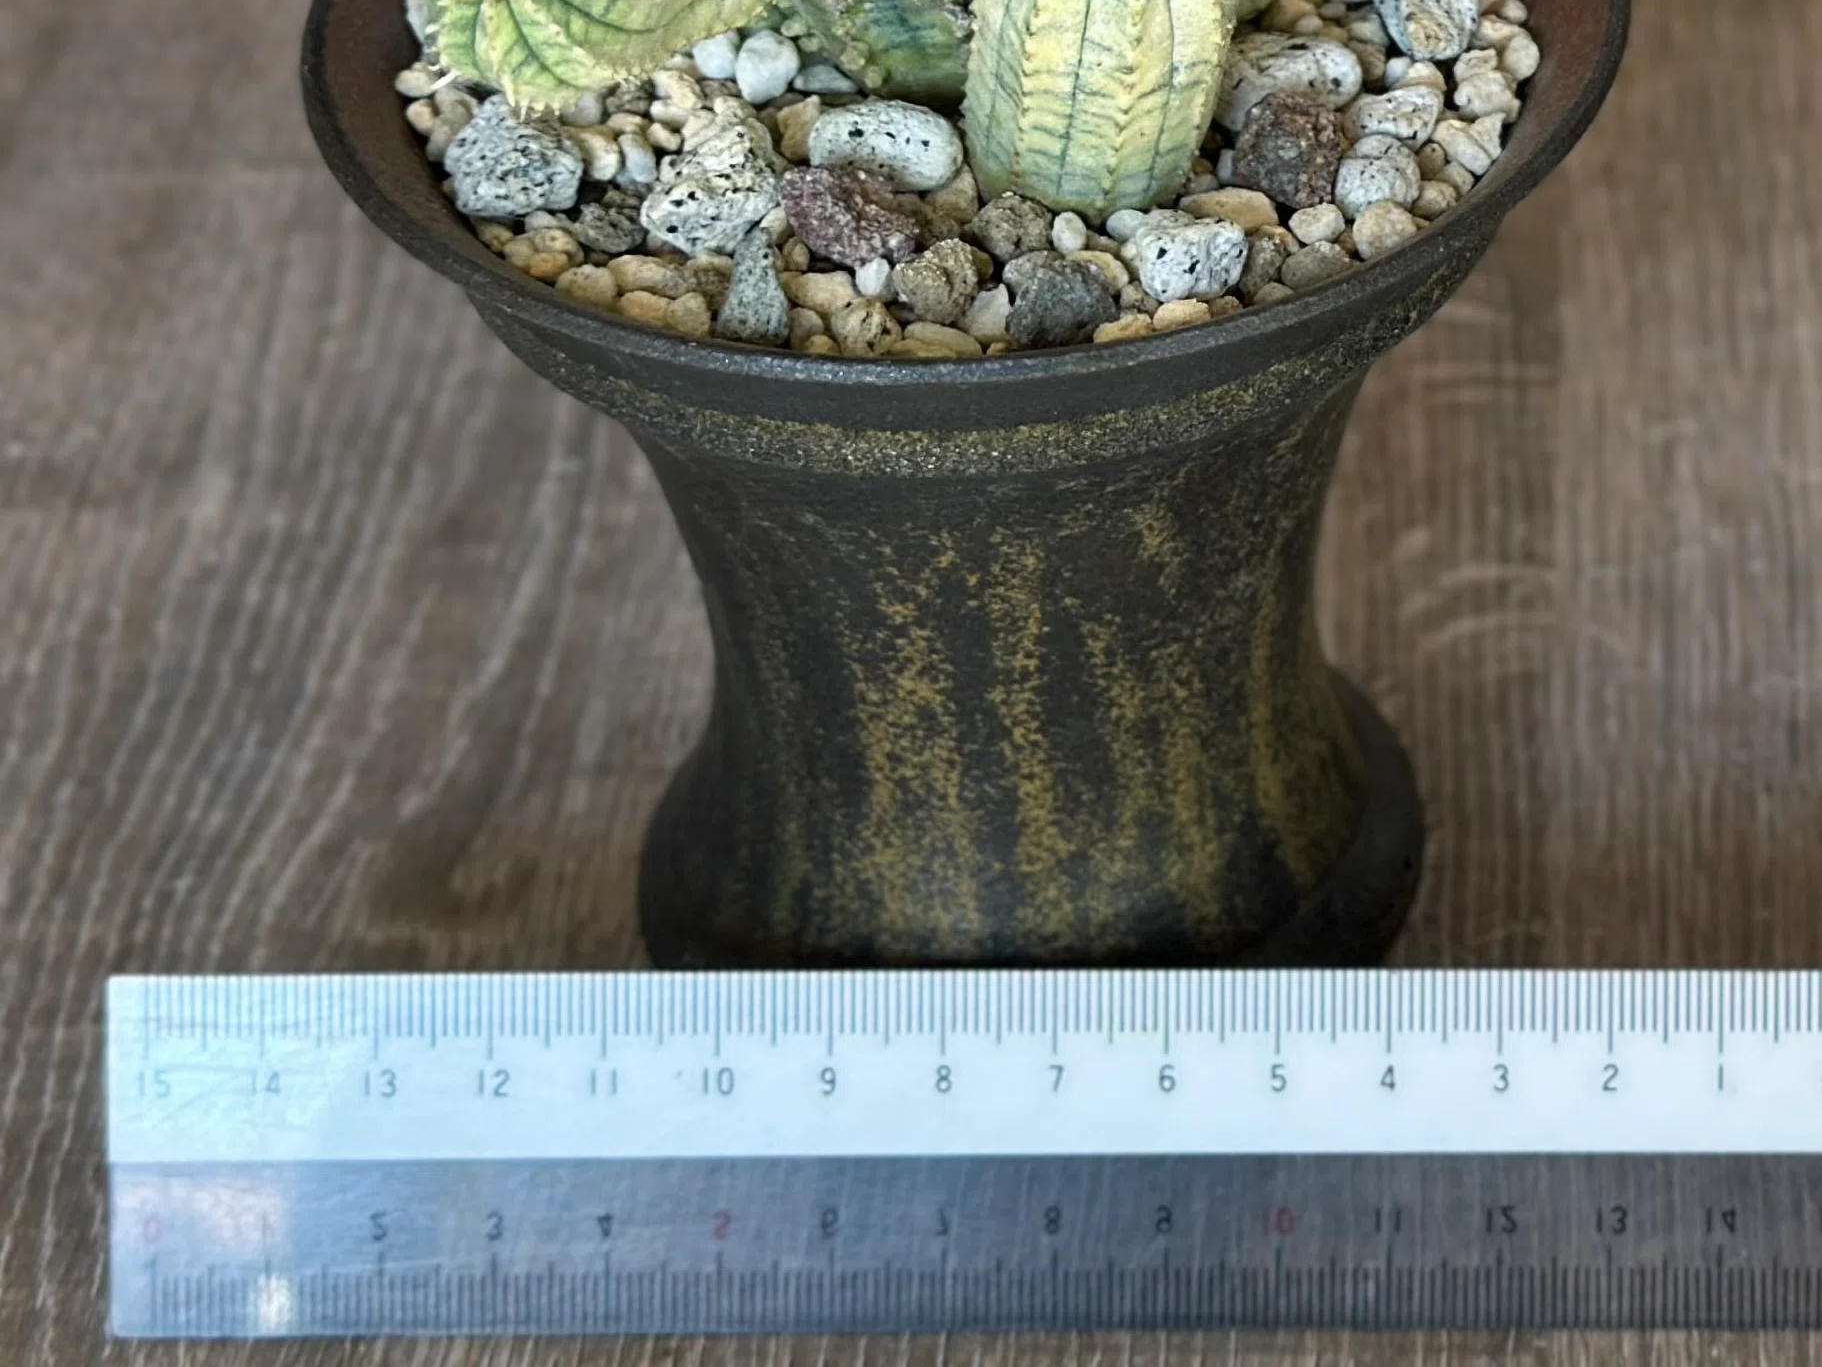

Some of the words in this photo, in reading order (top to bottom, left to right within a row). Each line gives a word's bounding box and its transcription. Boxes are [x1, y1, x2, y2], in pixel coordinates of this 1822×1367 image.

[138, 1069, 171, 1098] 15
[250, 1070, 281, 1097] 14
[363, 1068, 398, 1100] 13
[477, 1068, 511, 1099] 12
[589, 1069, 618, 1096] 11
[702, 1066, 735, 1097] 10
[819, 1066, 837, 1098] 9
[935, 1064, 952, 1094] 8
[1049, 1064, 1065, 1093] 7
[1158, 1063, 1177, 1094] 6
[1270, 1063, 1288, 1094] 5
[1379, 1064, 1397, 1091] 4
[1492, 1063, 1510, 1094] 3
[1601, 1063, 1620, 1093] 2
[1717, 1064, 1725, 1092] 1
